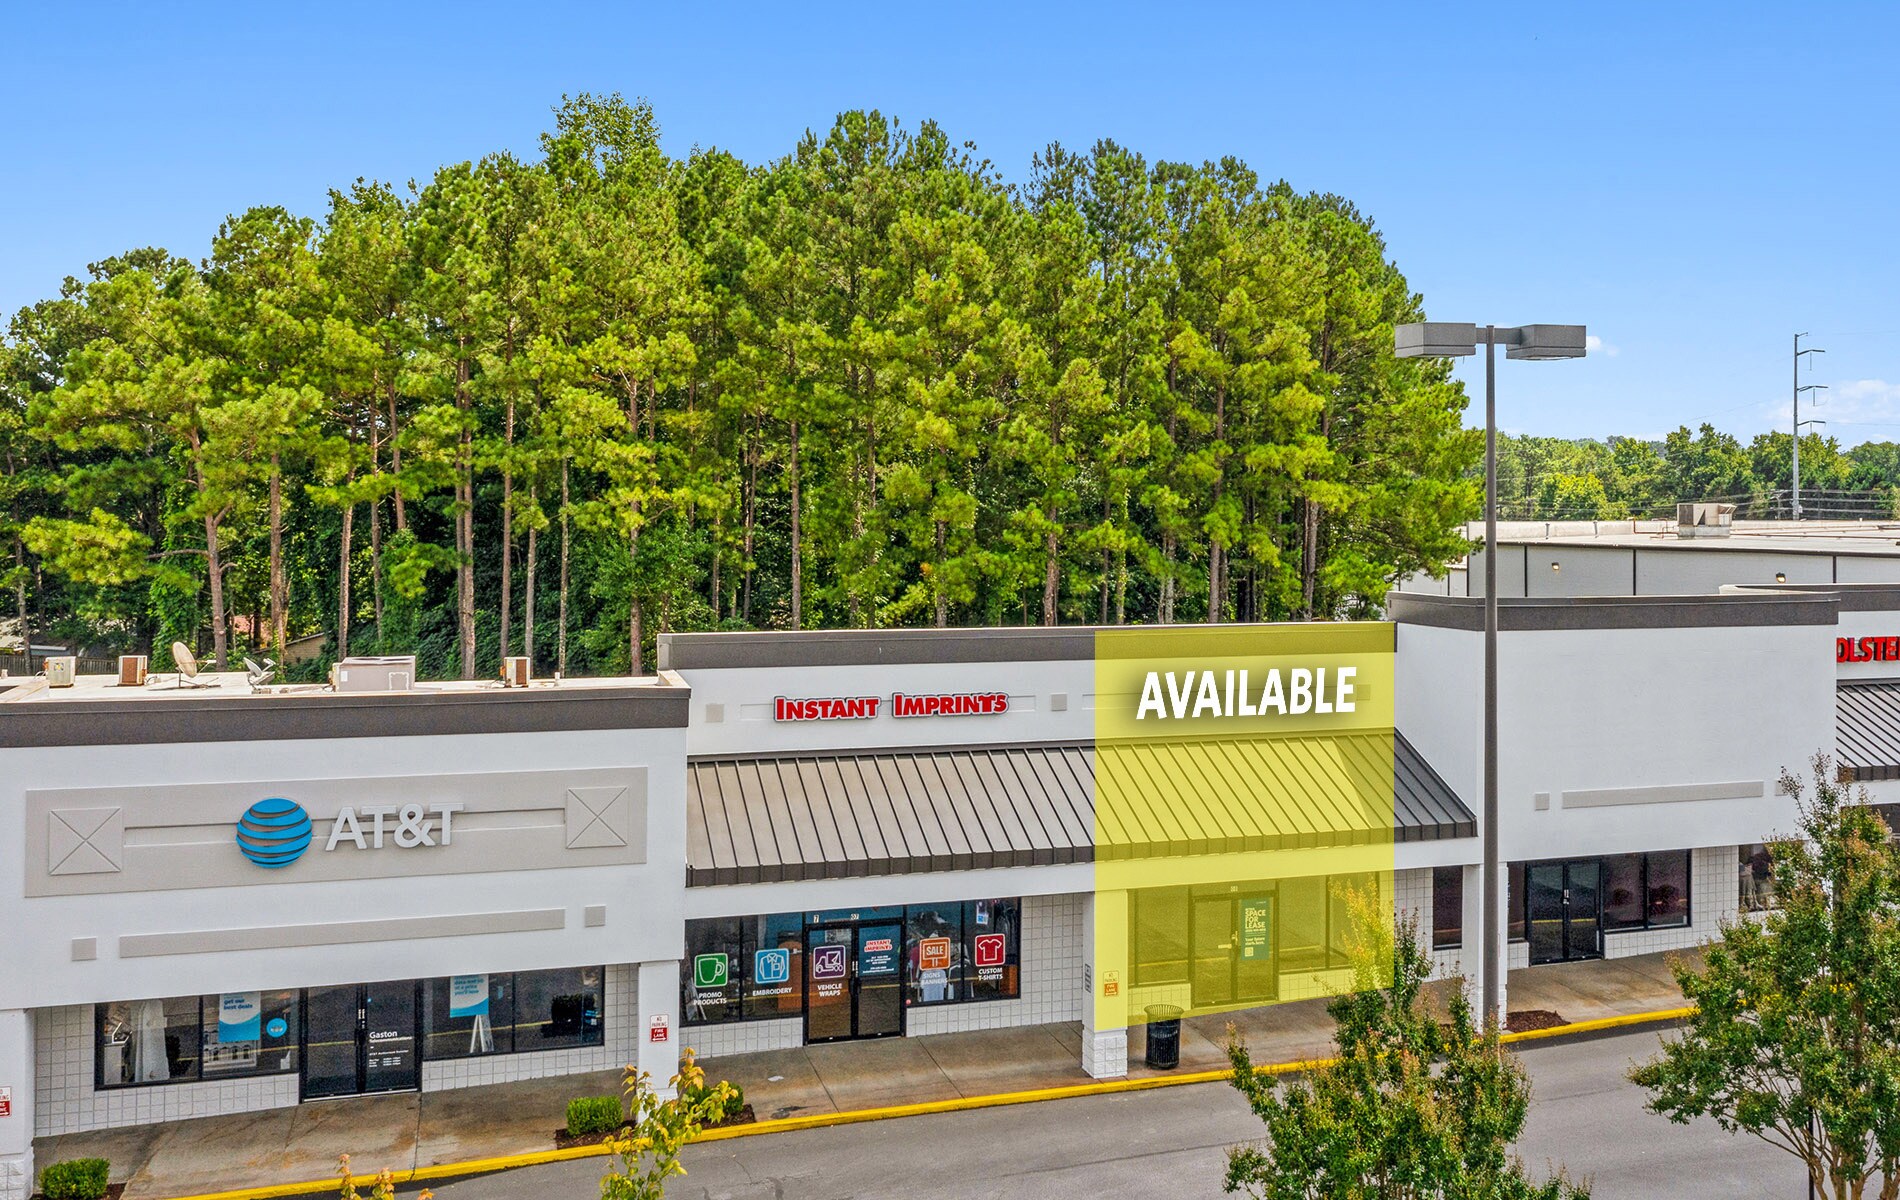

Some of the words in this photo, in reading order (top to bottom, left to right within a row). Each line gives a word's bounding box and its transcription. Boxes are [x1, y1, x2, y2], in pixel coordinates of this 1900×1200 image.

[1836, 636, 1900, 663] OLSTE
[776, 698, 880, 720] INSTANT
[894, 694, 1007, 717] IMPRINTS
[325, 802, 465, 851] AT&T
[1245, 915, 1259, 923] FOR
[1245, 921, 1266, 929] LEASE
[926, 945, 944, 956] SALE
[818, 983, 842, 991] VEHICLE
[752, 987, 793, 996] EMBROIDERY
[693, 998, 727, 1006] PRODUCTS
[369, 1031, 398, 1039] Gaston
